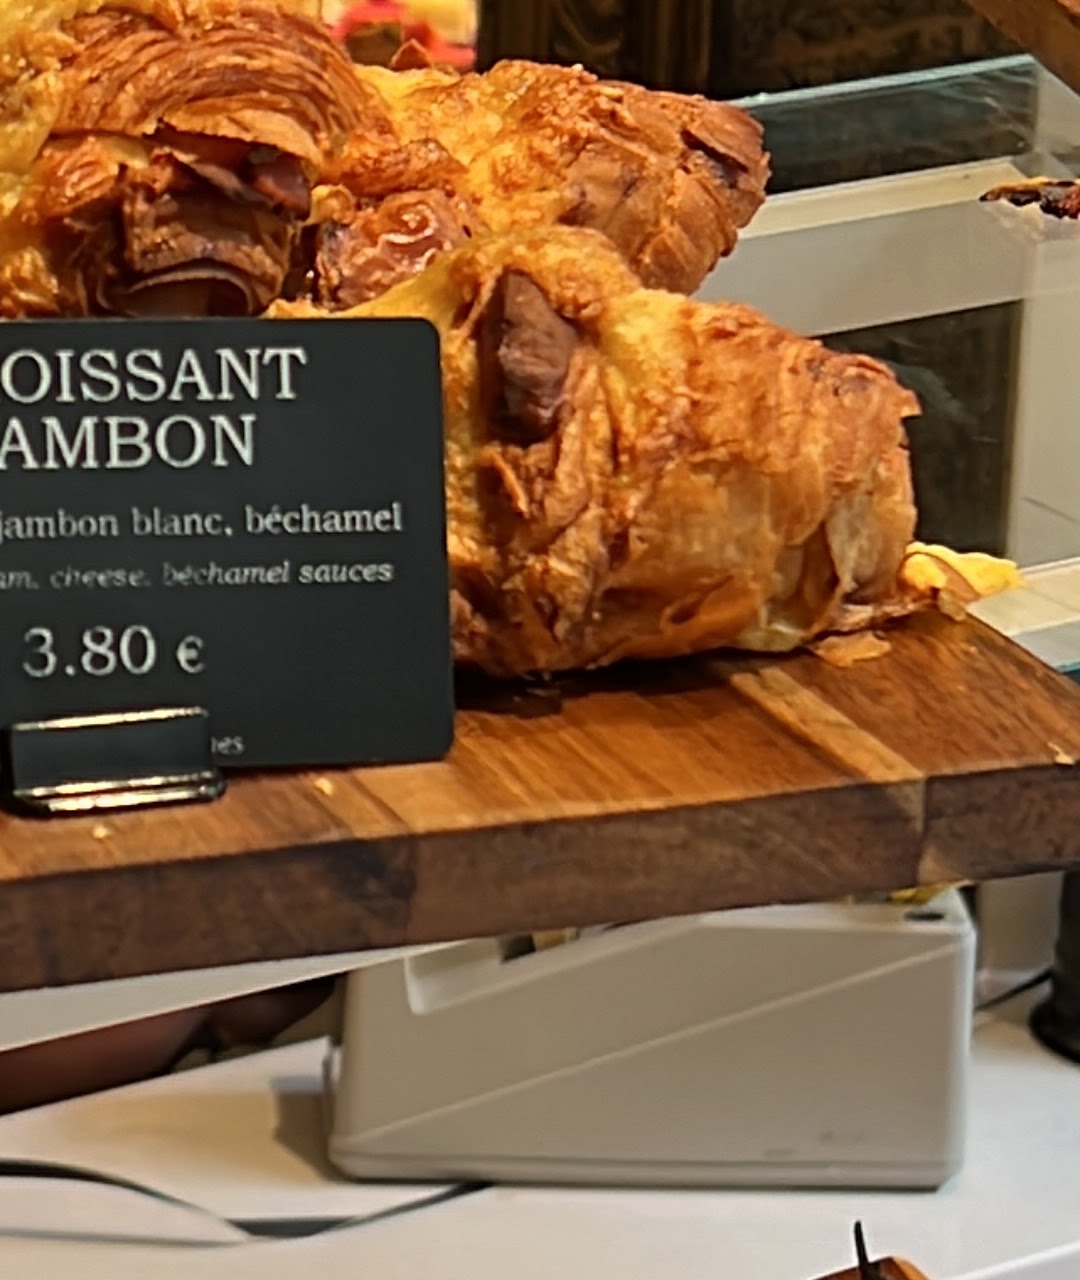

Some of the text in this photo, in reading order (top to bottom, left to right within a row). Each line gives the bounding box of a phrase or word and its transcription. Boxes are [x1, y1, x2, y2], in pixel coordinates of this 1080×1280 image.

[131, 506, 233, 537] blanc,
[245, 501, 404, 534] béchamel
[298, 562, 395, 584] sauces
[22, 624, 205, 678] 3.80 €
